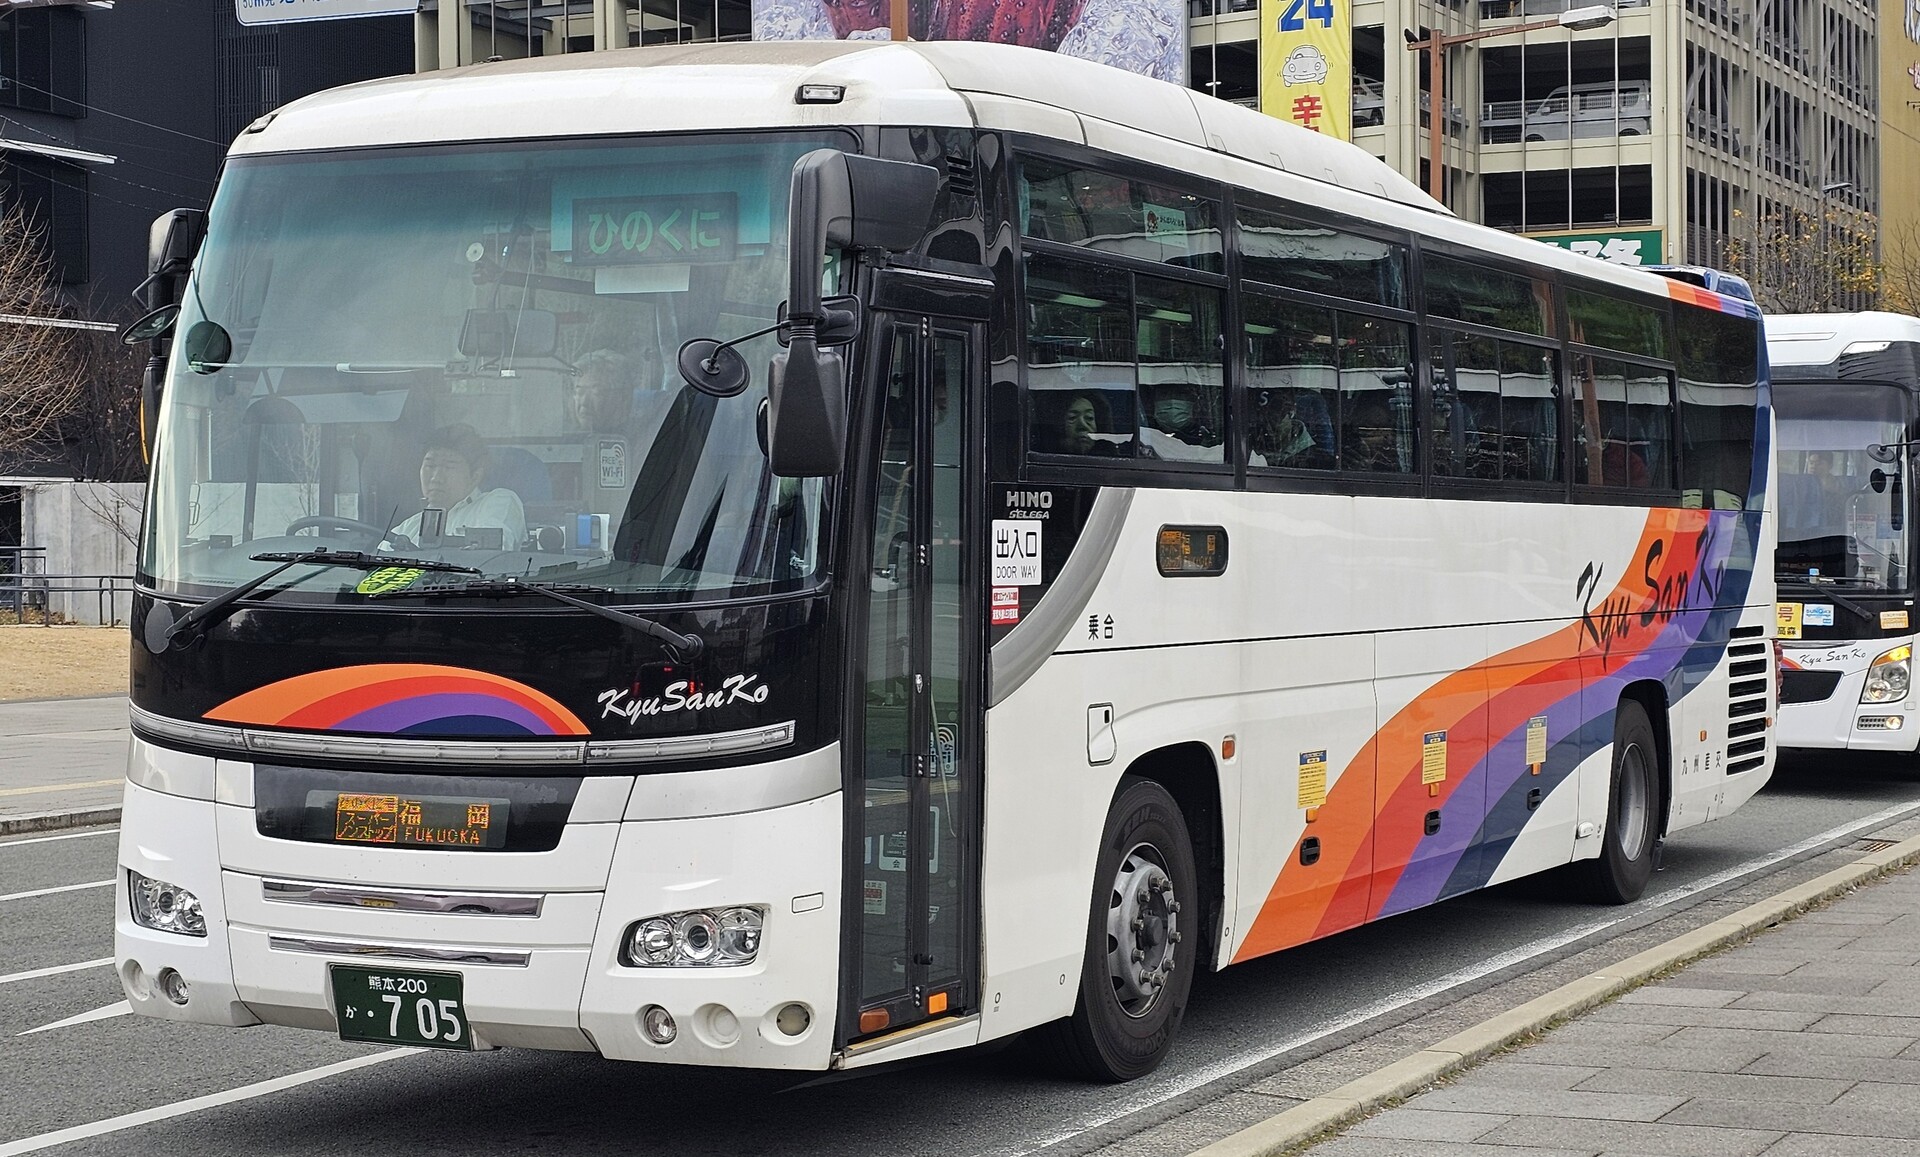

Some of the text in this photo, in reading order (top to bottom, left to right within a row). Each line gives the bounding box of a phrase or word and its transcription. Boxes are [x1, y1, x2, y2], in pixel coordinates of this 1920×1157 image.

[1278, 0, 1334, 32] 24
[1292, 95, 1323, 132] 辛
[588, 209, 721, 254] ひのくに
[602, 466, 623, 478] Wi-Fi
[1006, 491, 1053, 508] HINO
[996, 528, 1038, 559] 出入口
[996, 565, 1038, 579] DOOR WAY
[1576, 523, 1725, 673] Kyu San Ko
[1088, 613, 1115, 641] 乗合
[1799, 648, 1867, 666] Kyu San Ko
[597, 673, 770, 726] KyuSanKo
[344, 812, 390, 826] スーパー
[337, 825, 395, 841] ノンストップ
[404, 827, 481, 845] FUKUOKA
[345, 1004, 358, 1019] か
